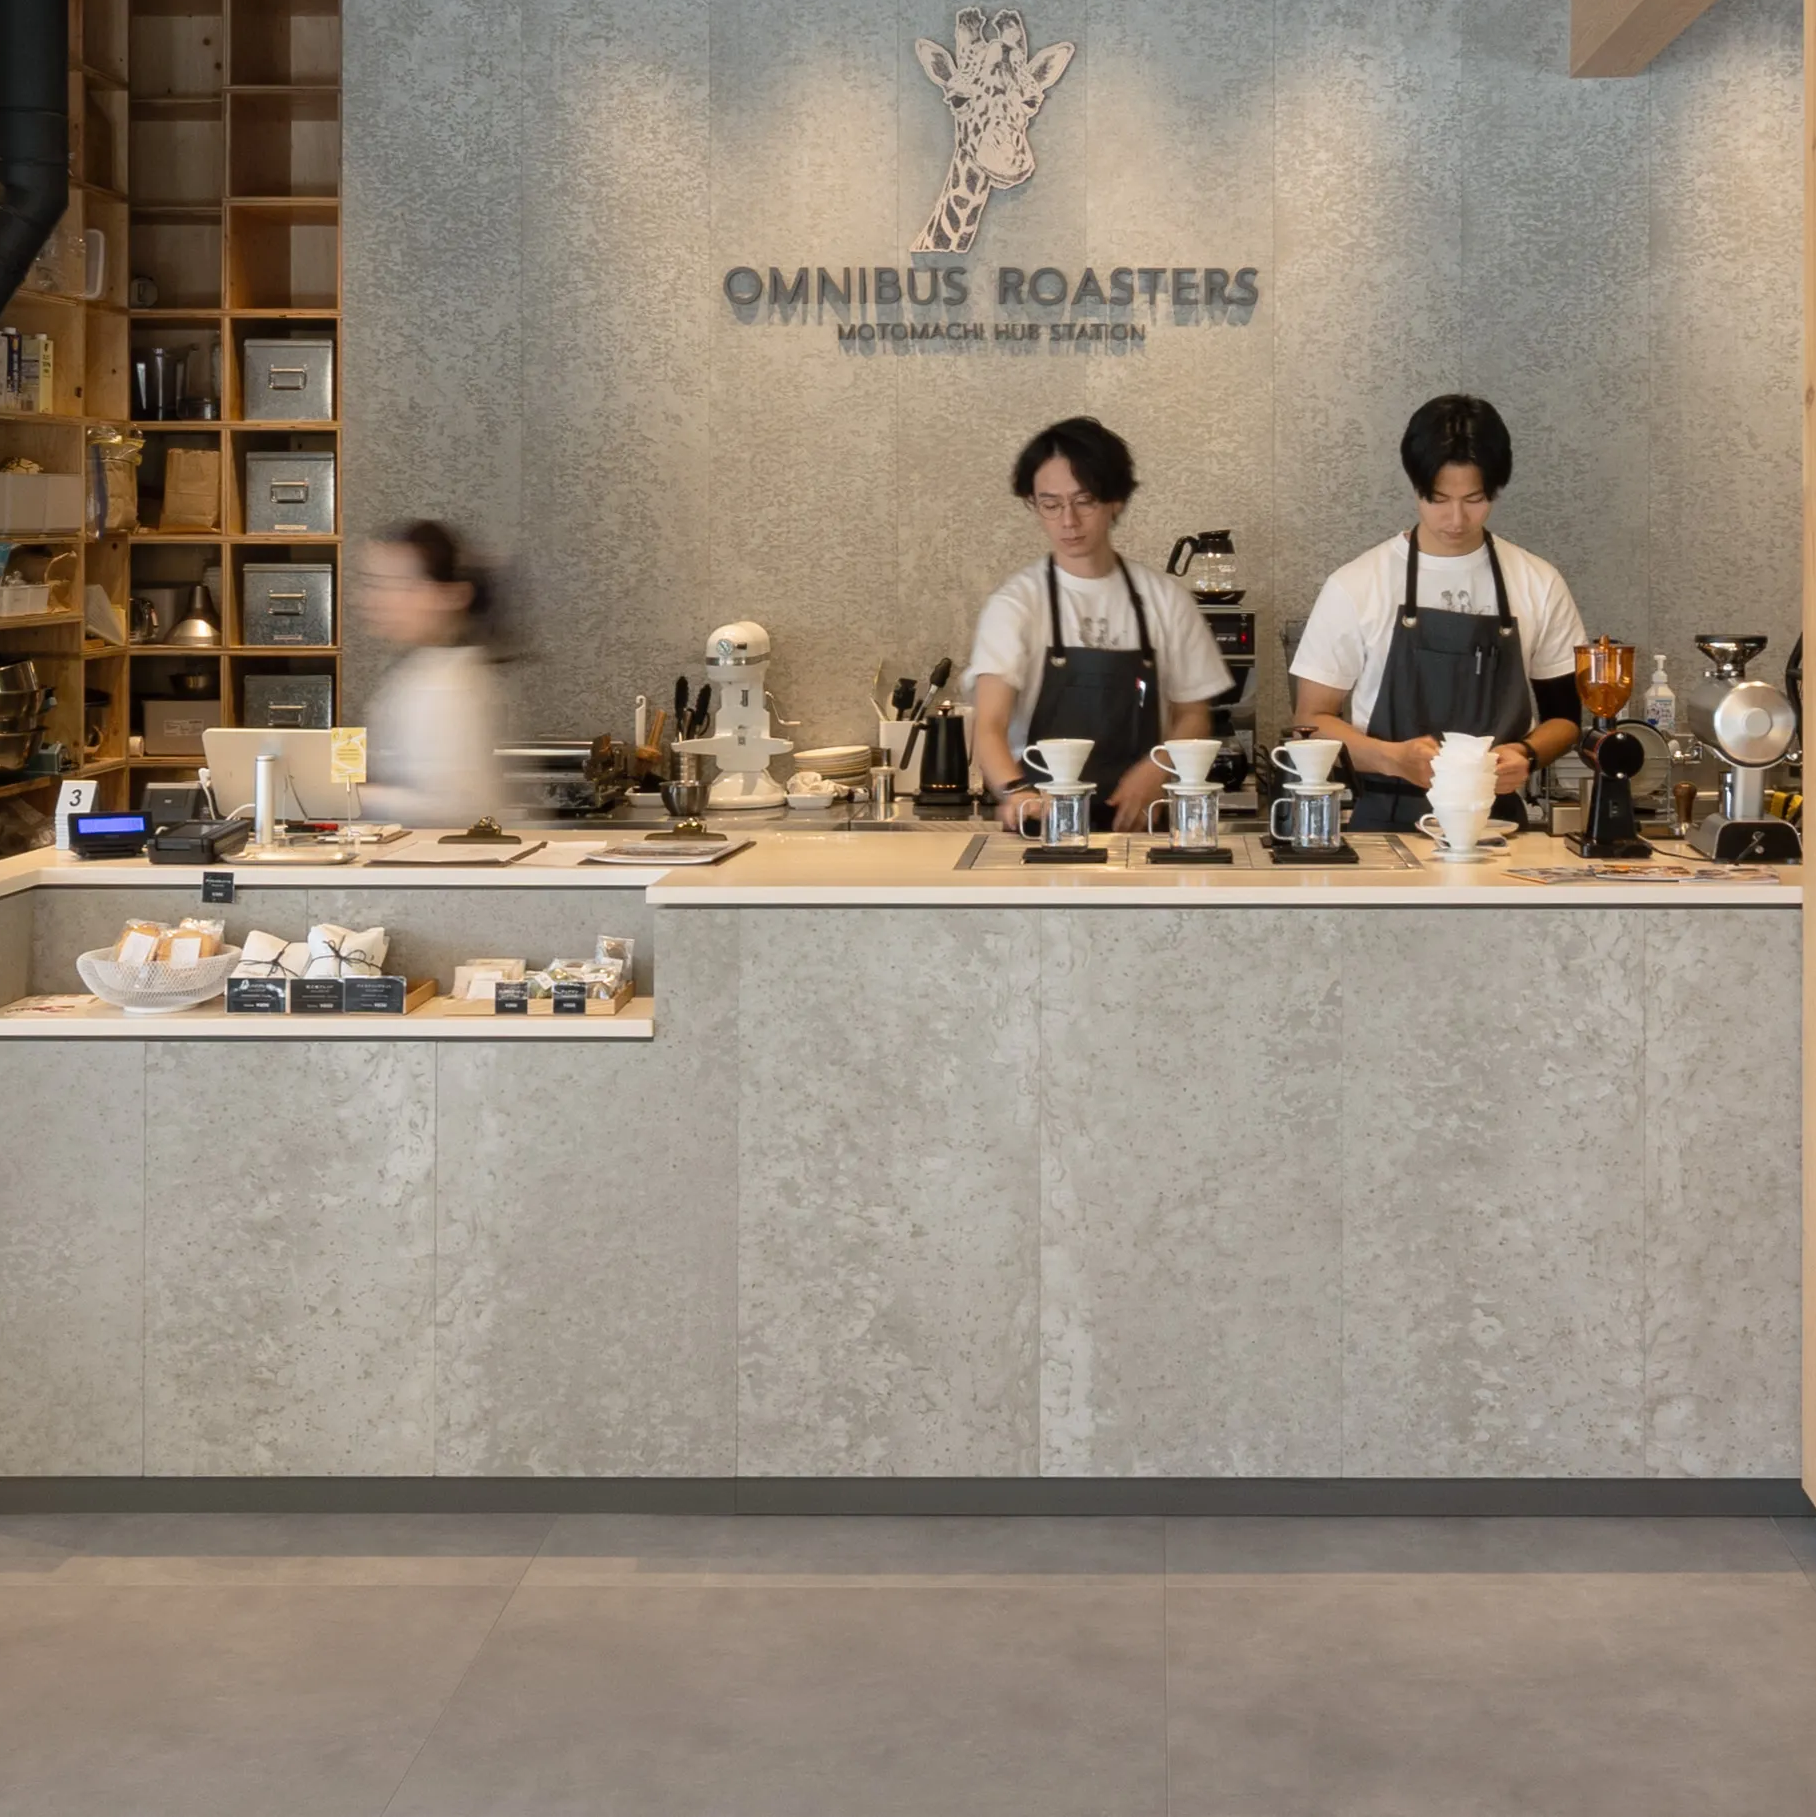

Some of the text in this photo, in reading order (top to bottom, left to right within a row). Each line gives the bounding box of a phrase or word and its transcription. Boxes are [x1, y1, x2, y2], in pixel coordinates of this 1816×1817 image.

[723, 265, 1260, 306] OMNIBUS ROASTERS
[837, 322, 1146, 342] MOTOMACHI HUB STATION
[69, 789, 82, 807] 3
